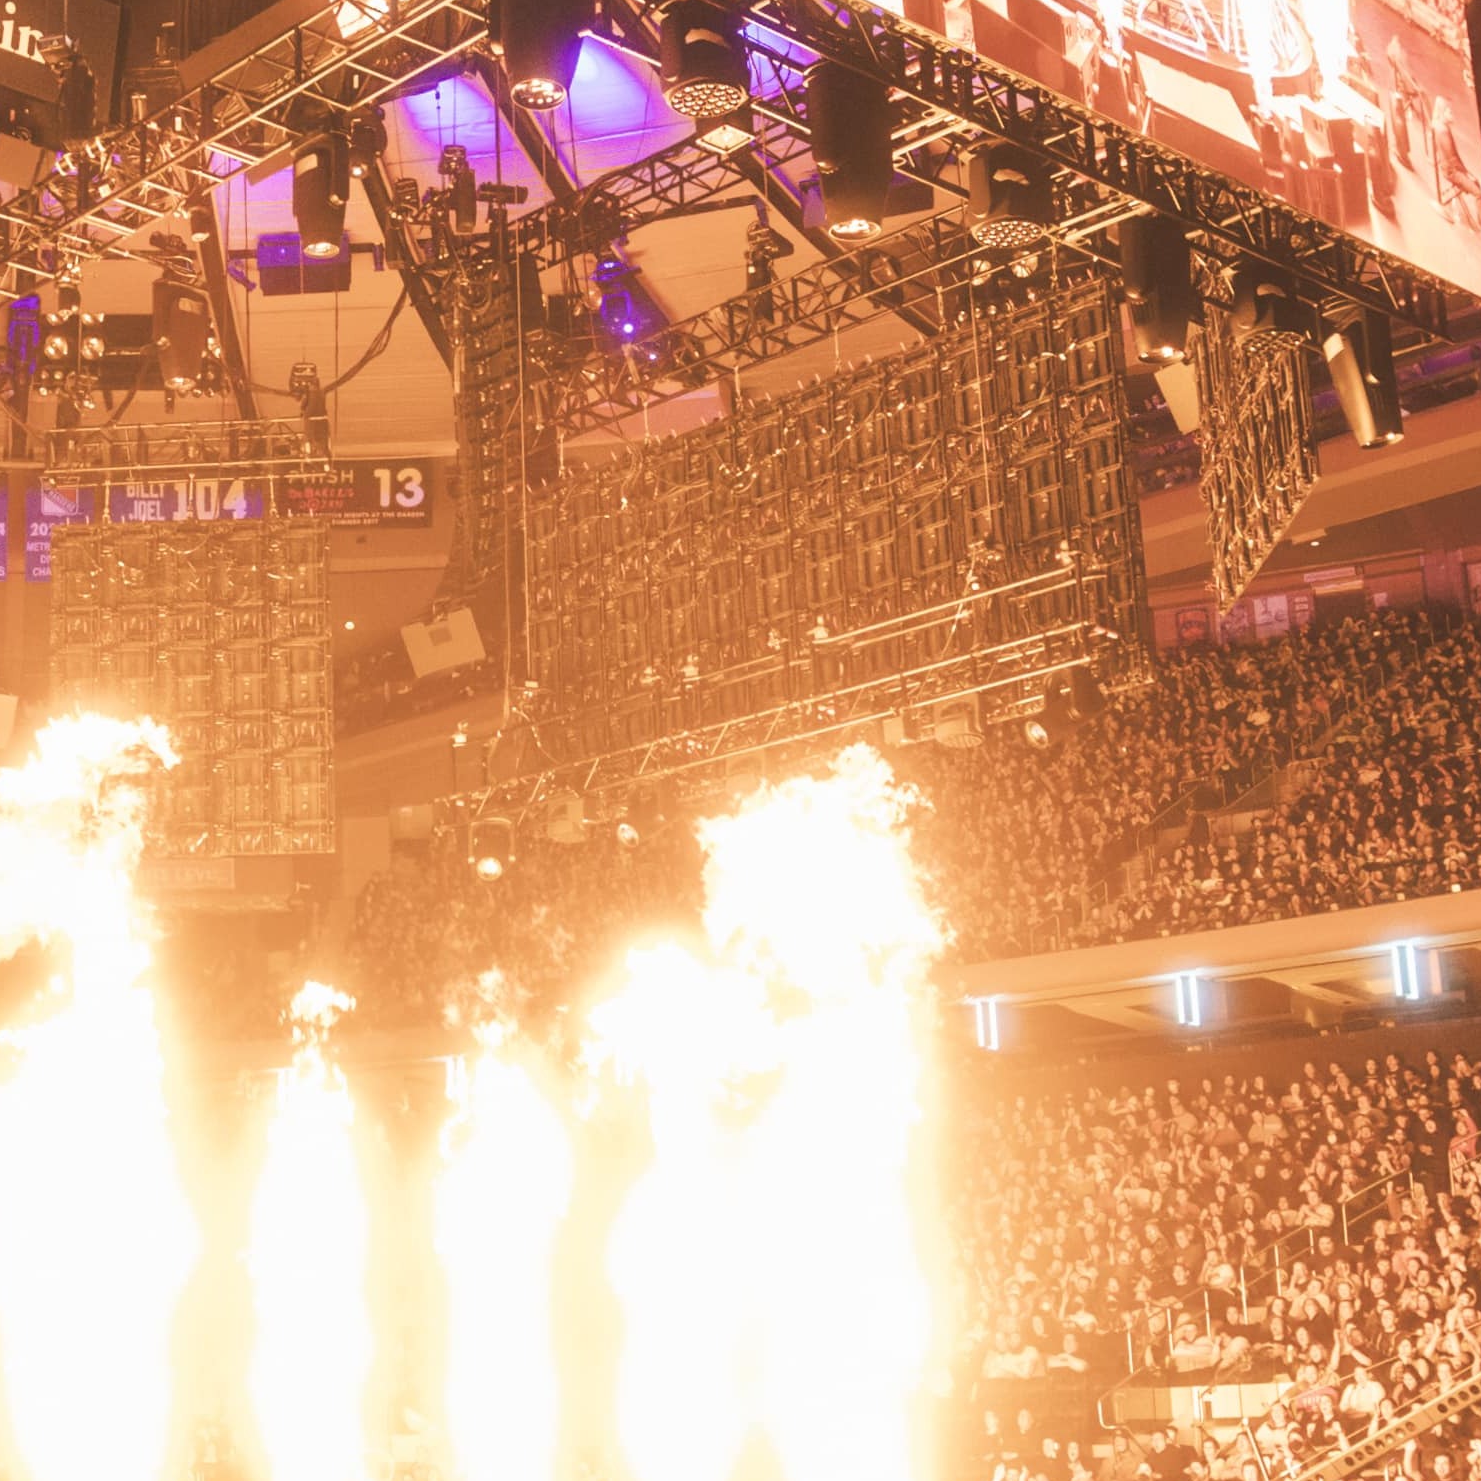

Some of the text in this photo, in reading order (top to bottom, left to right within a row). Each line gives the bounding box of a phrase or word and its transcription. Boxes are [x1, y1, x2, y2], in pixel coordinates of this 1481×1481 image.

[171, 479, 248, 521] 104
[373, 467, 425, 509] 13
[128, 499, 165, 522] JOEL
